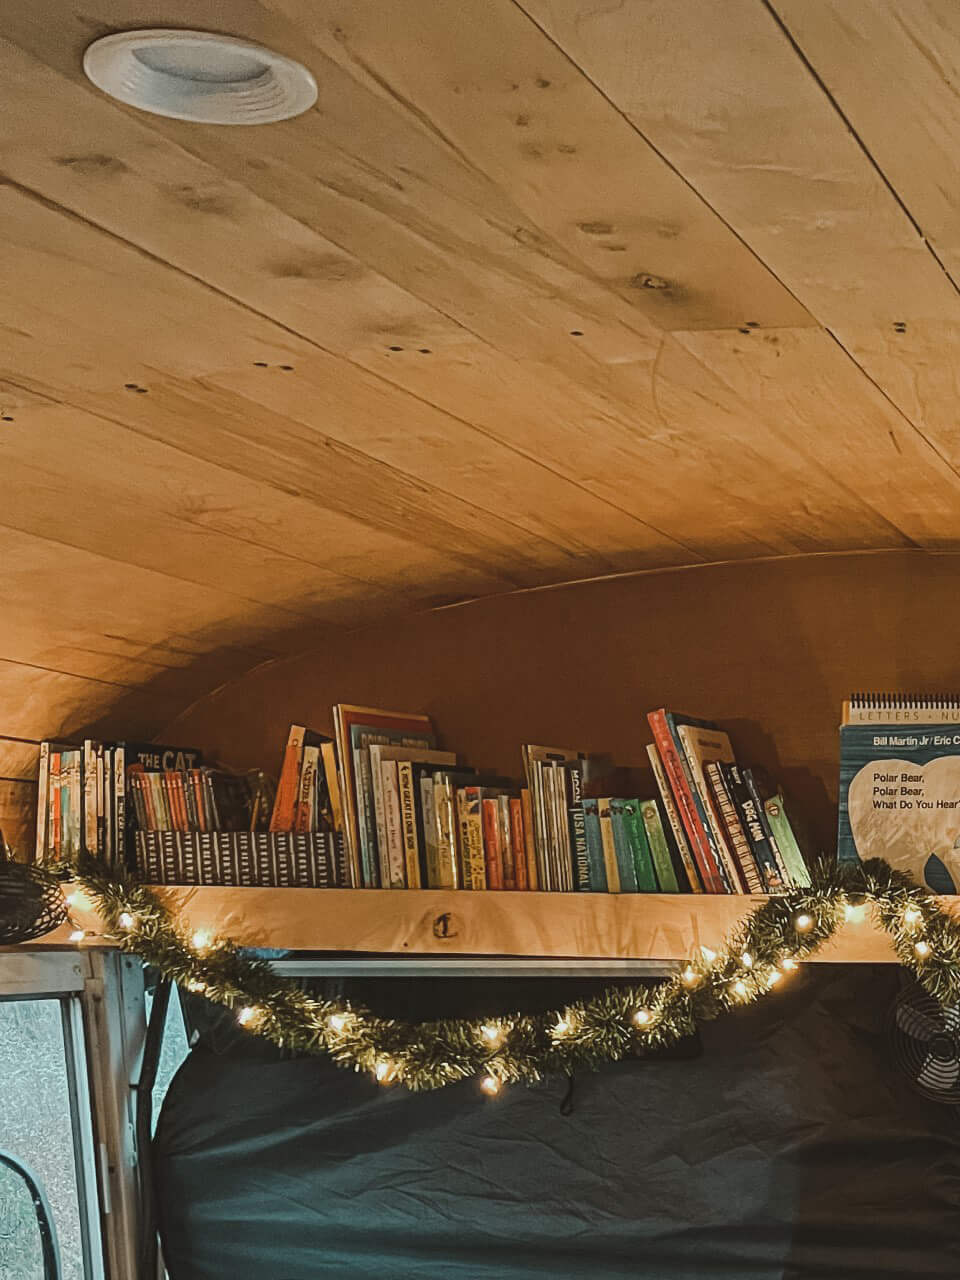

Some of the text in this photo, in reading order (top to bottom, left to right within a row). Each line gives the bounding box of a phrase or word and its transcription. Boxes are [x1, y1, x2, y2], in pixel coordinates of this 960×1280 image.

[859, 711, 919, 721] LETTERS
[873, 736, 887, 746] Bill
[889, 736, 918, 746] Martin
[137, 751, 198, 771] THE CAT
[873, 773, 925, 783] Polar Bear,
[873, 786, 925, 797] Polar Bear,
[872, 800, 897, 809] What
[900, 800, 913, 809] Do
[916, 800, 933, 809] You
[741, 800, 759, 822] DOG
[574, 813, 585, 835] USA
[575, 837, 589, 884] NATIONAL
